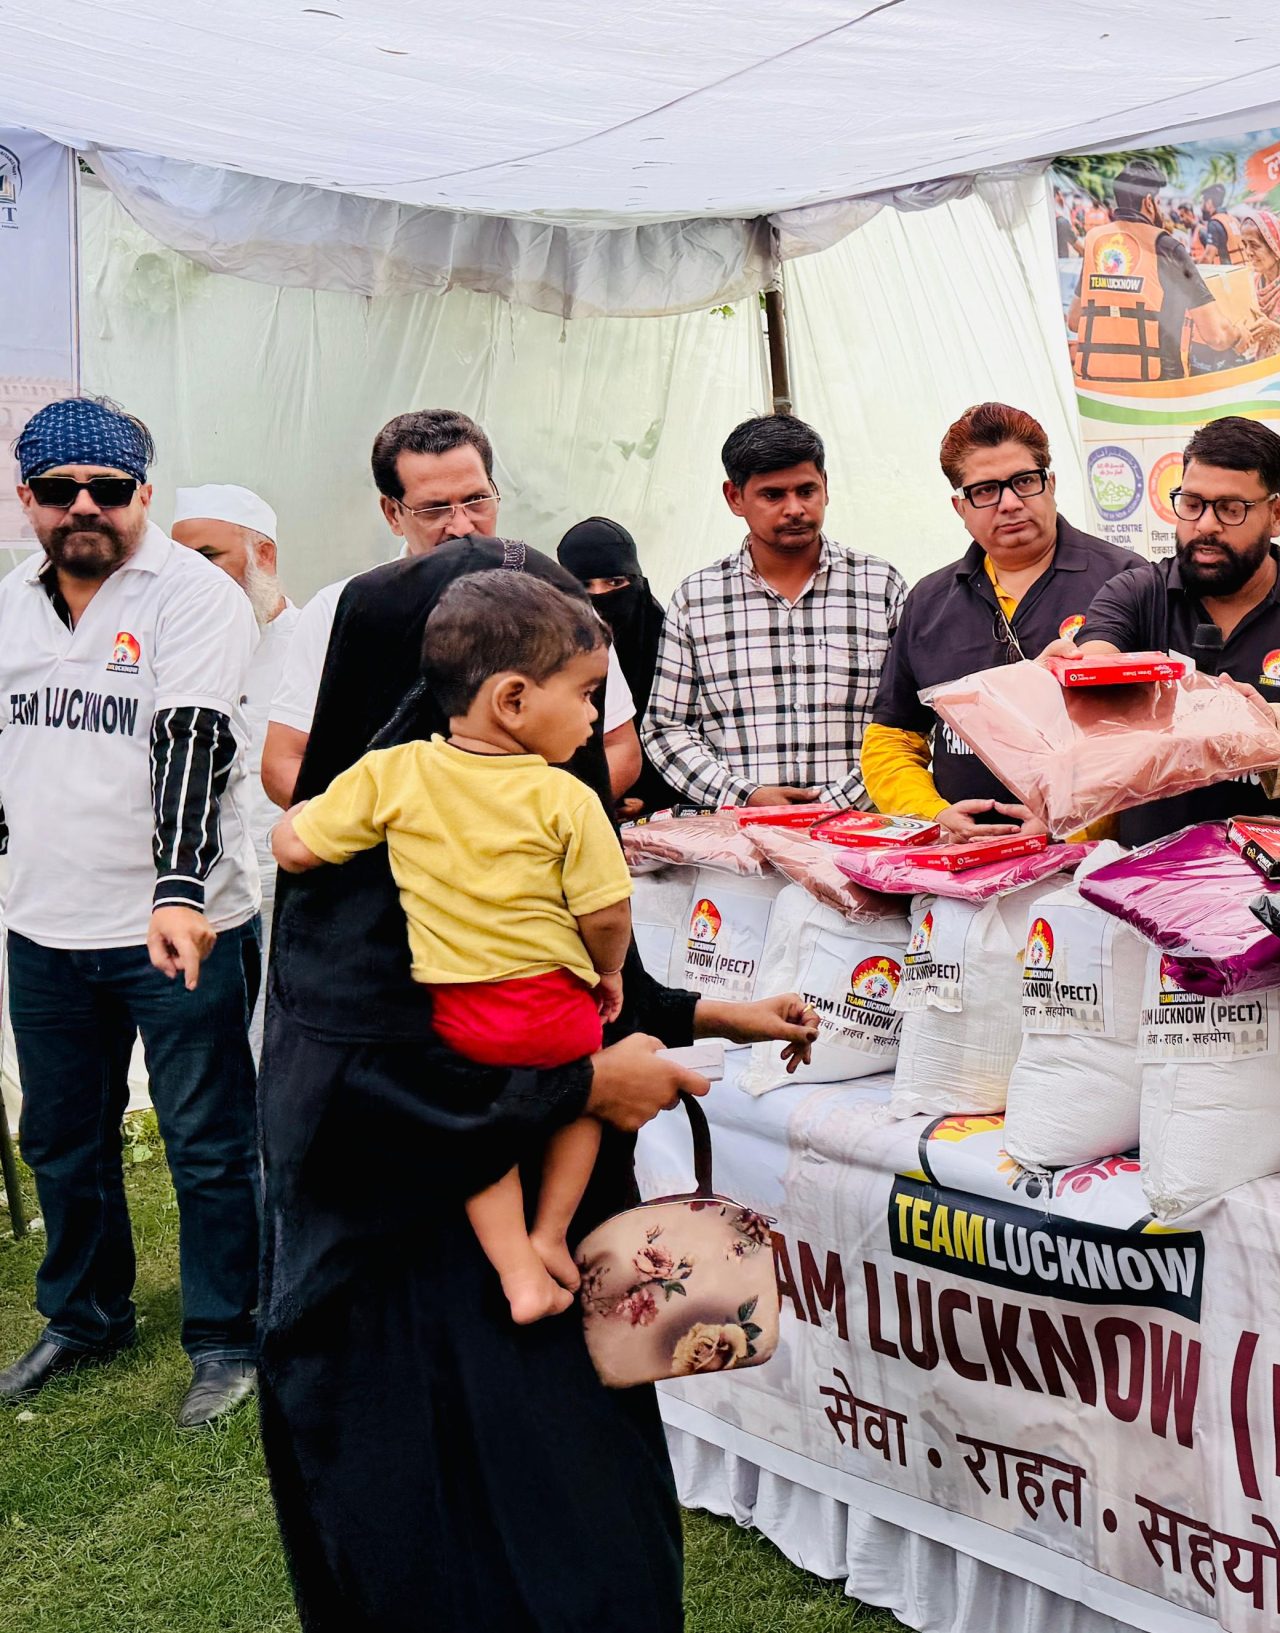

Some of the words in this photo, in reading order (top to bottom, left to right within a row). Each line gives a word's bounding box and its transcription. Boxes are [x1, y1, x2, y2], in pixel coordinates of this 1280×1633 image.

[1116, 523, 1143, 532] CENTRE
[45, 687, 139, 736] LUCKNOW
[716, 953, 755, 978] (PECT)
[930, 962, 960, 983] PECT)
[1055, 981, 1098, 1005] (PECT)
[836, 1004, 894, 1030] LUCKNOW
[1154, 1006, 1206, 1025] LUCKNOW
[1211, 1001, 1262, 1027] (PECT)
[1164, 1033, 1183, 1045] राहत
[1192, 1028, 1231, 1045] सहयोग
[770, 1230, 850, 1342] AM
[862, 1260, 1203, 1450] LUCKNOW
[819, 1367, 908, 1468] सेवा
[955, 1430, 1087, 1526] राहत
